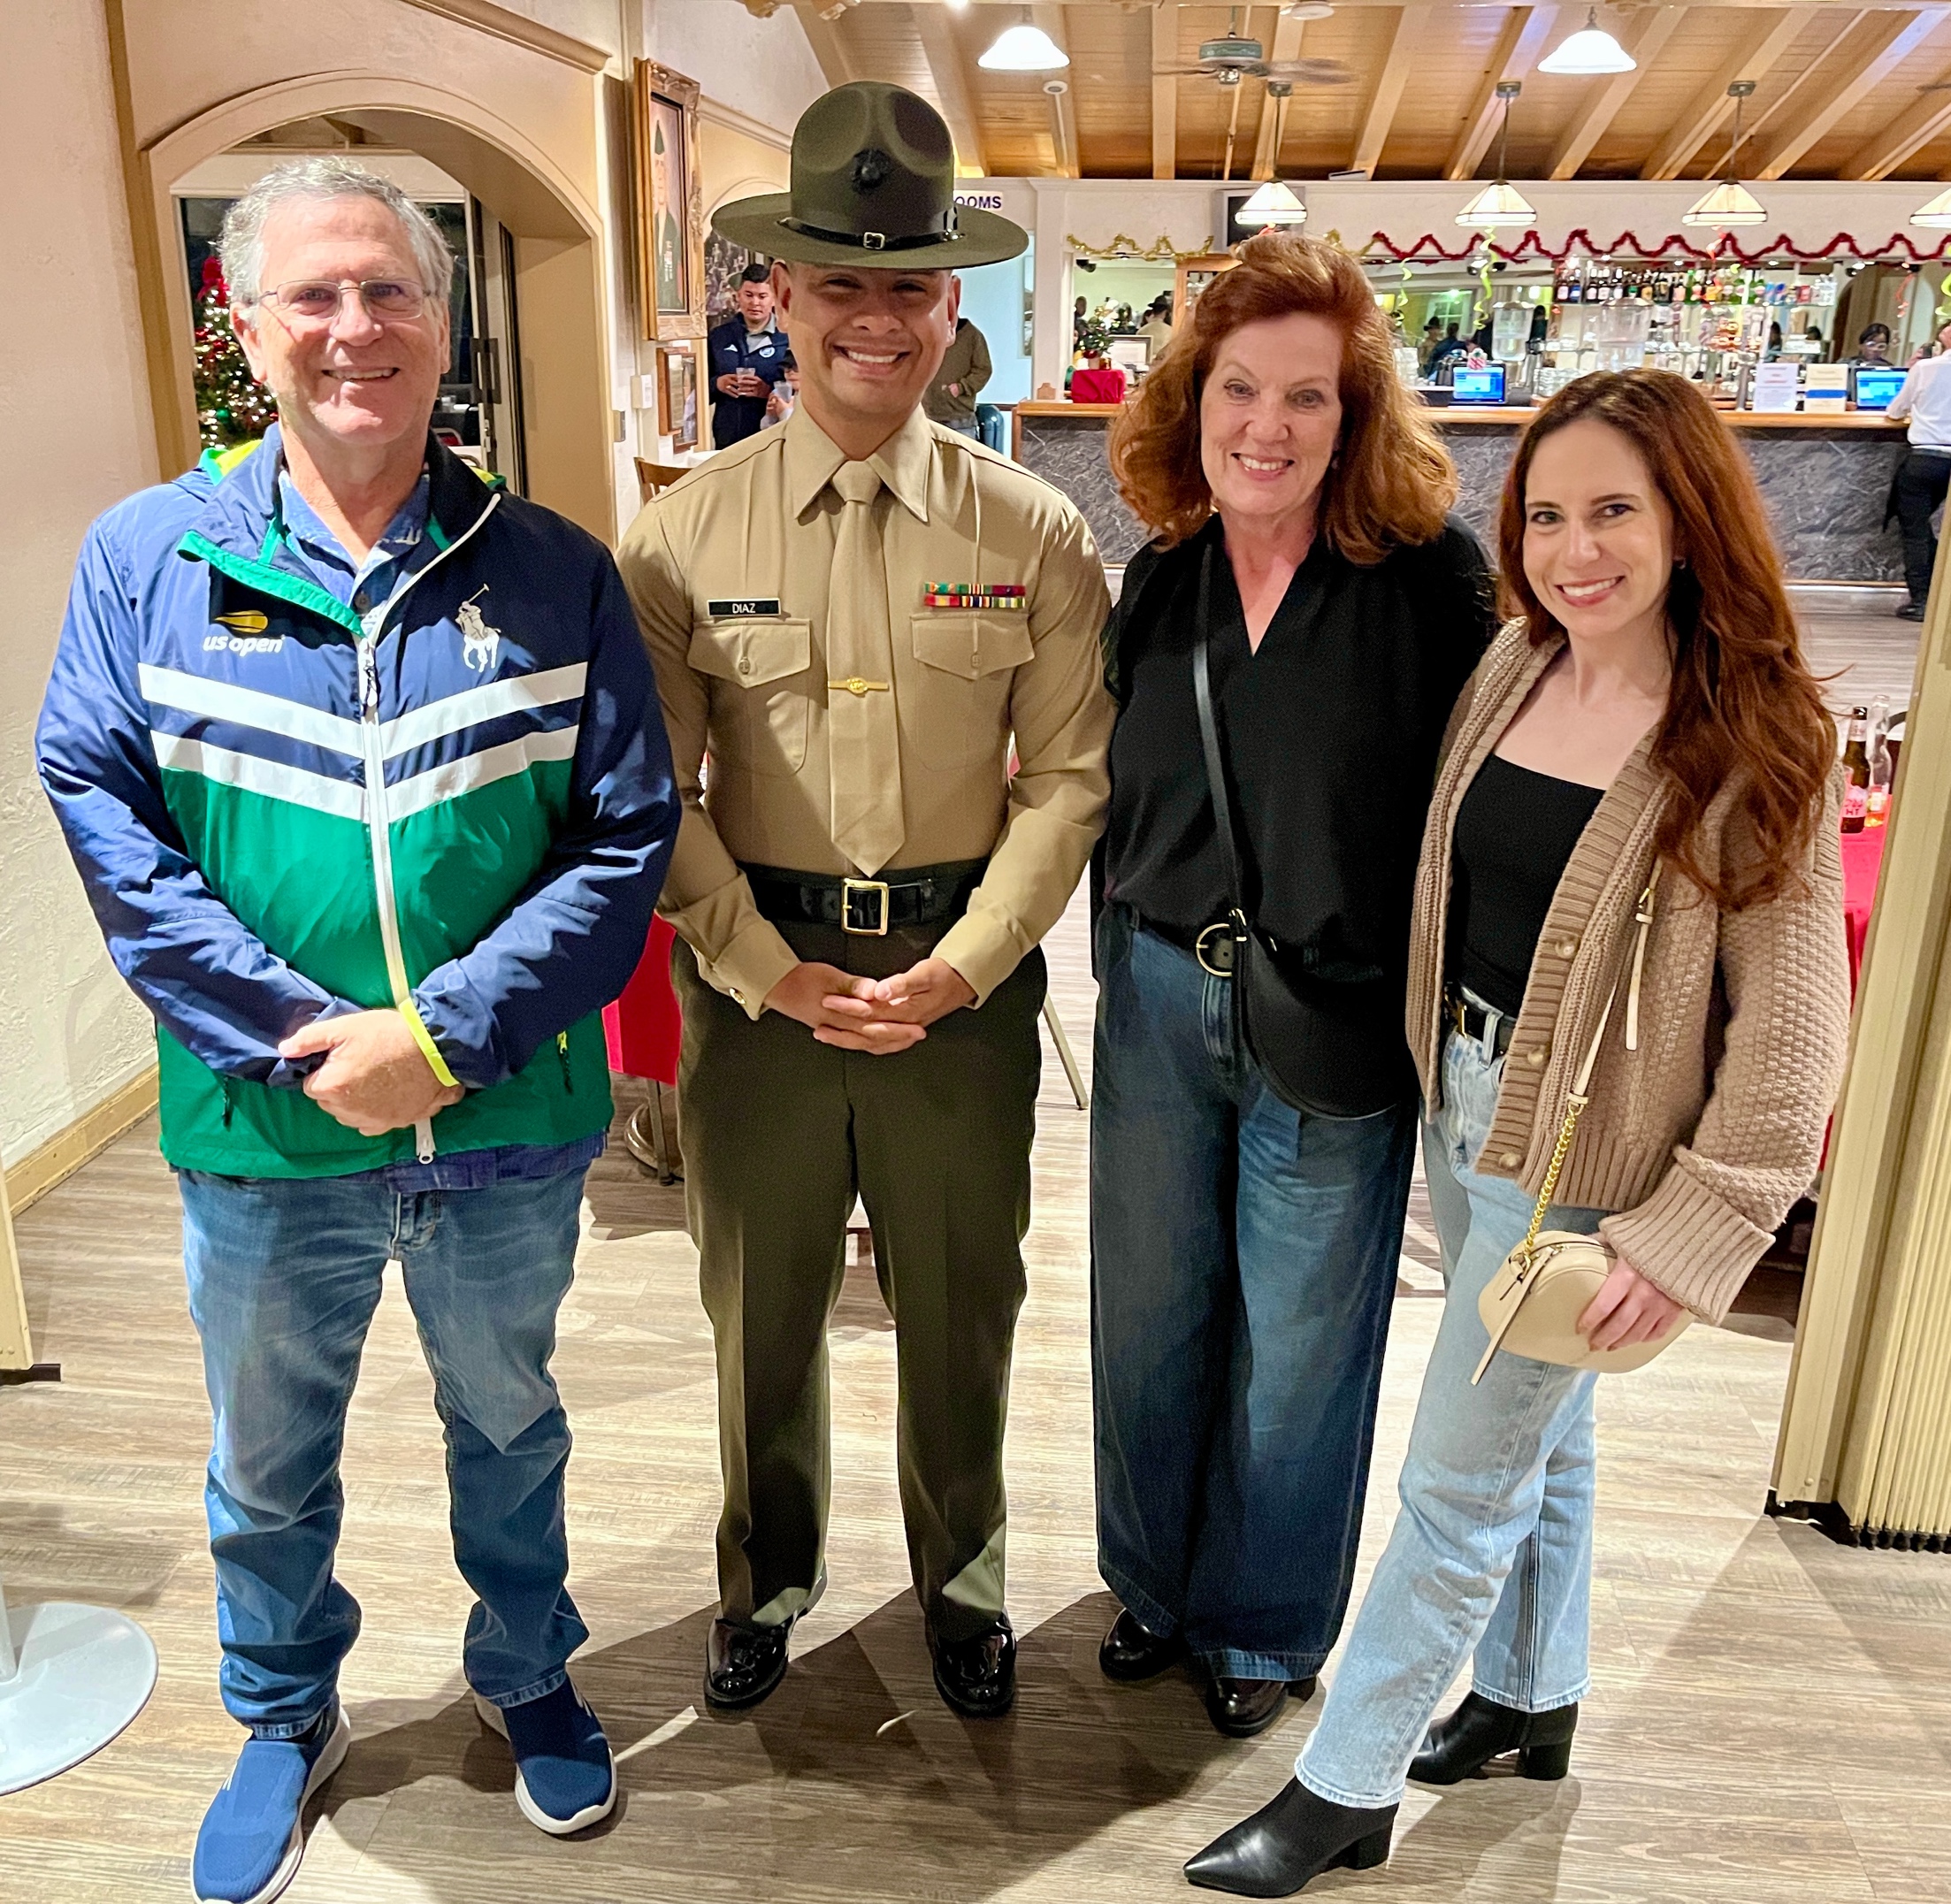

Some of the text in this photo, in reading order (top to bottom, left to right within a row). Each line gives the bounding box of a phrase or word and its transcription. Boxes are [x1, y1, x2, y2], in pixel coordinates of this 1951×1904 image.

[731, 602, 756, 614] DIAZ
[203, 635, 283, 657] us open
